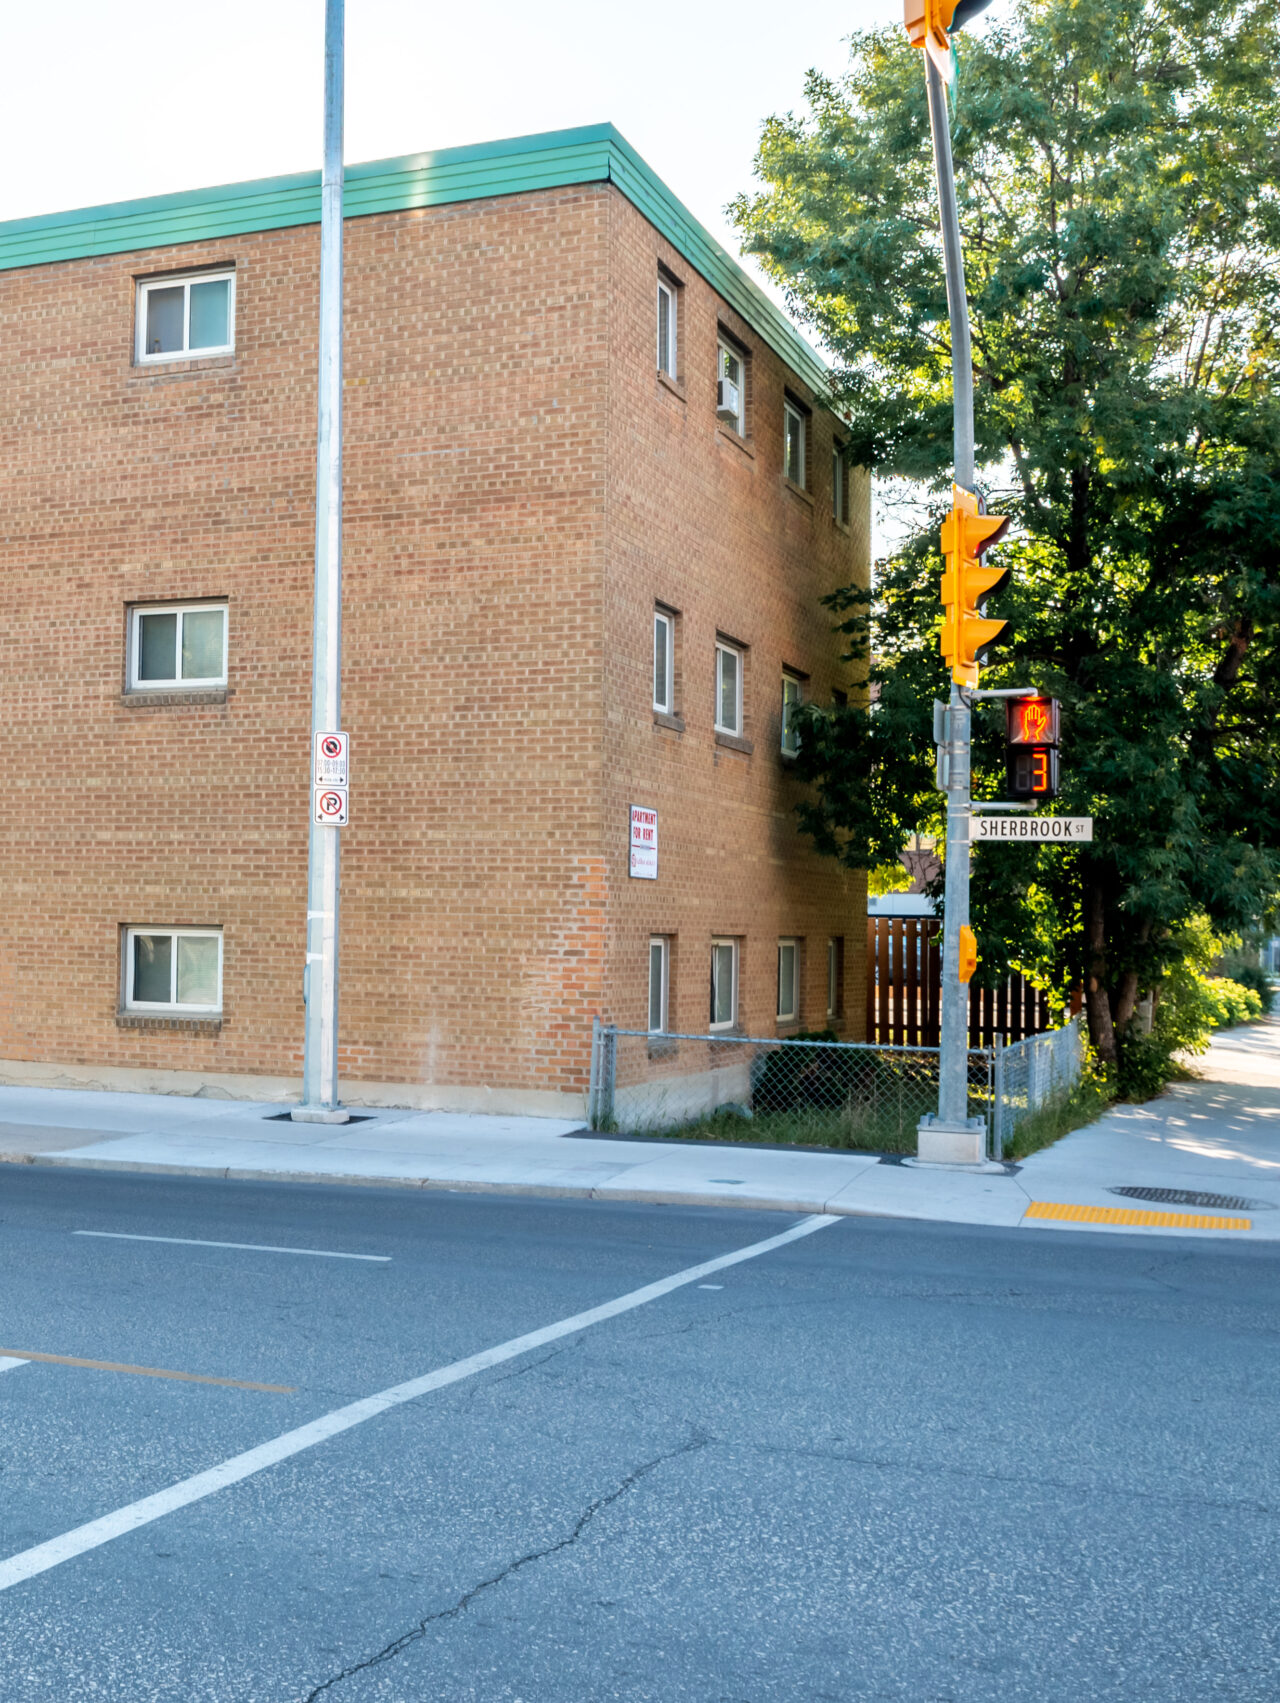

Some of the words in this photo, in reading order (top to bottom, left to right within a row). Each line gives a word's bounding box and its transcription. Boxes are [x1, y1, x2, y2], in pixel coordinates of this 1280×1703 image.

[1032, 753, 1047, 791] 3
[632, 810, 656, 825] APARTMENT
[633, 826, 641, 840] FOR
[643, 828, 653, 841] RENT
[980, 820, 1072, 837] SHERBROOK
[1076, 824, 1084, 833] ST
